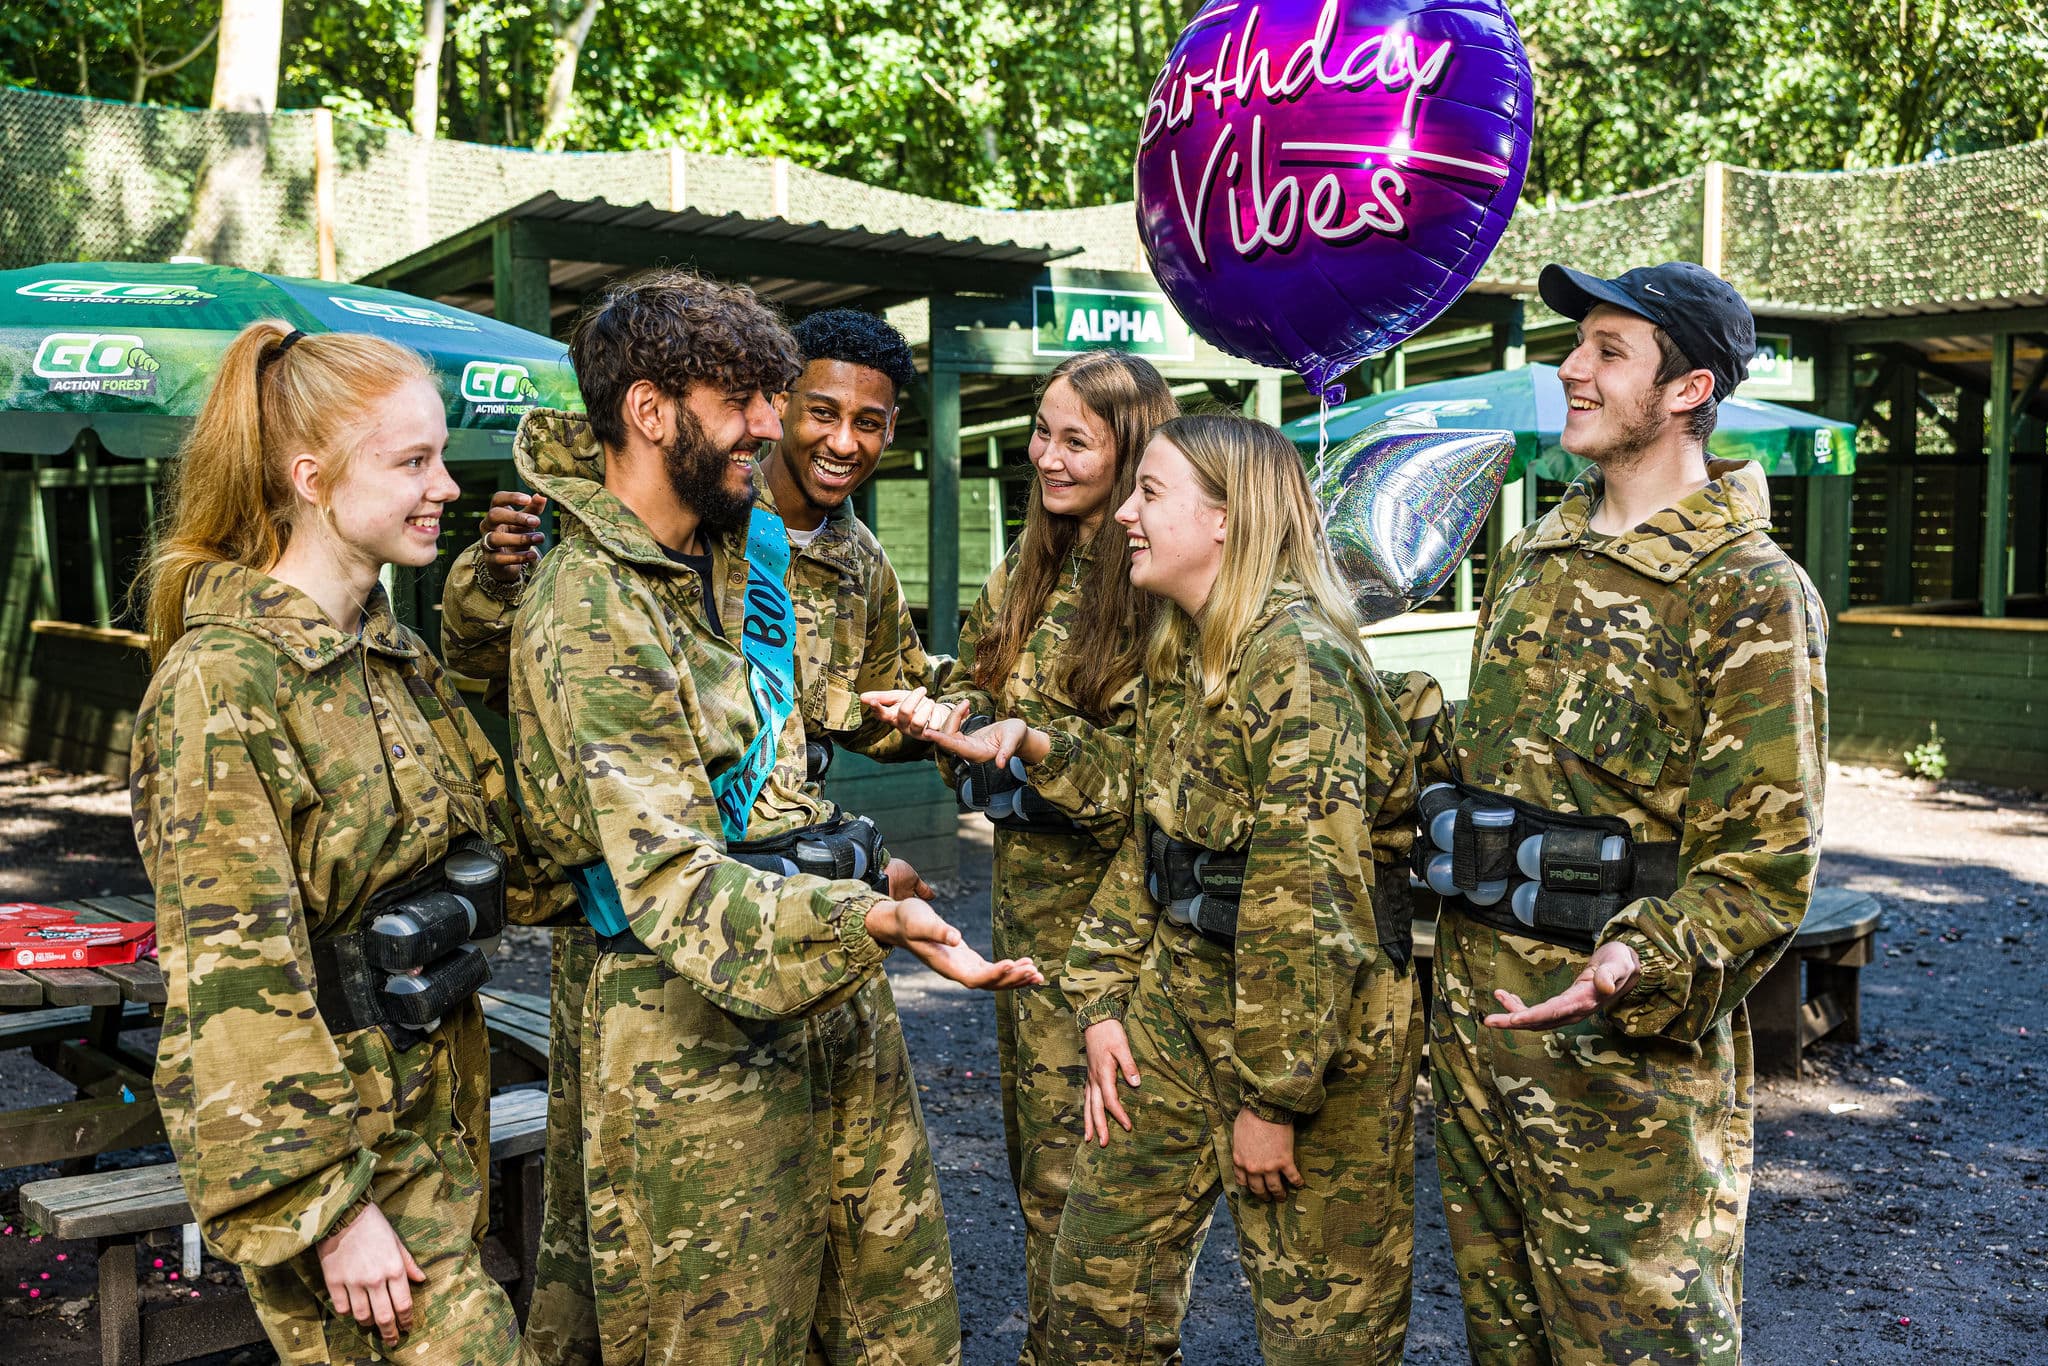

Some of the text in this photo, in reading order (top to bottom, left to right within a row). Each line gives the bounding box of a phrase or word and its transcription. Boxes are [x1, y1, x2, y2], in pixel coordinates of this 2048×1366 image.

[1140, 0, 1453, 145] Birthday
[1171, 115, 1406, 263] Vibes
[20, 280, 182, 298] GO
[42, 296, 199, 306] ACTION FOREST
[1067, 308, 1164, 343] ALPHA
[35, 335, 140, 377] GO
[54, 379, 150, 391] ACTION FOREST
[463, 362, 527, 402] GO
[475, 404, 505, 414] ACTION
[743, 564, 789, 648] BOY
[1549, 868, 1599, 881] PROFIELD
